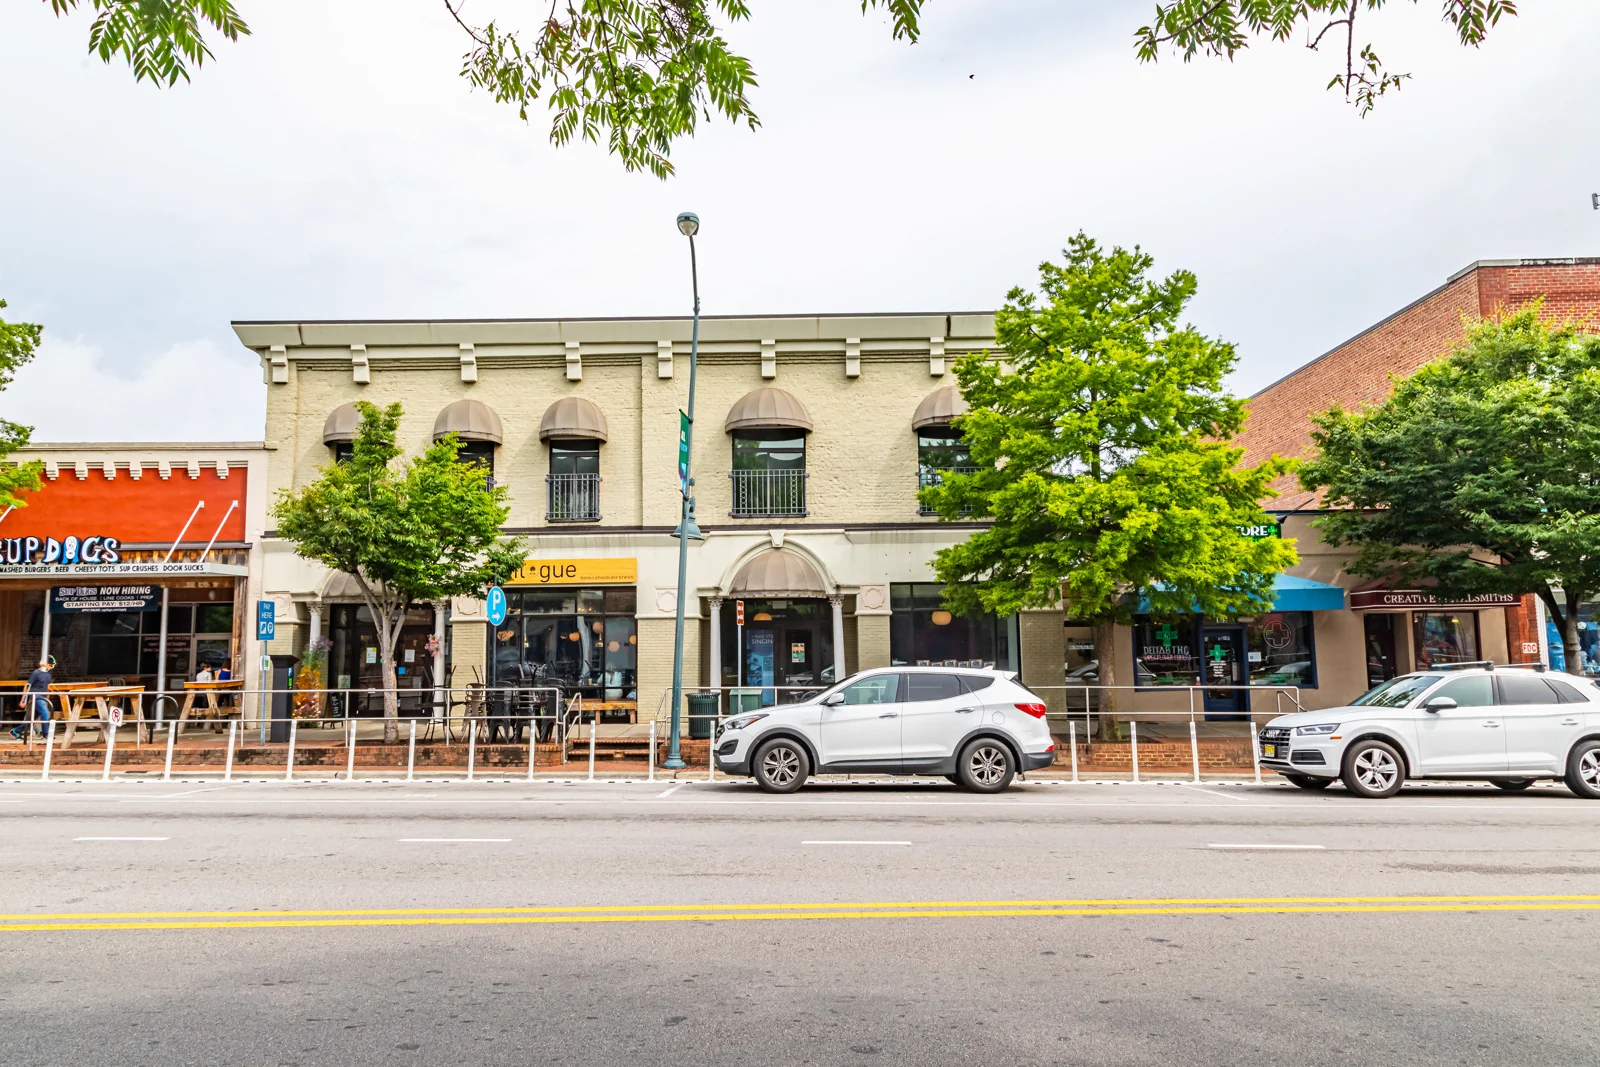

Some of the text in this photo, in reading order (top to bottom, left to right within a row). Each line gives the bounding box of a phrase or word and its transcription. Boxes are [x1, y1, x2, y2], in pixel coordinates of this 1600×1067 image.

[1234, 525, 1268, 536] ORE
[100, 586, 121, 595] NOW
[121, 586, 151, 595] HIRING
[492, 590, 501, 611] P
[1383, 593, 1514, 604] CREATIVE LSMITHS
[261, 611, 273, 619] HERE
[1523, 644, 1537, 652] FDC
